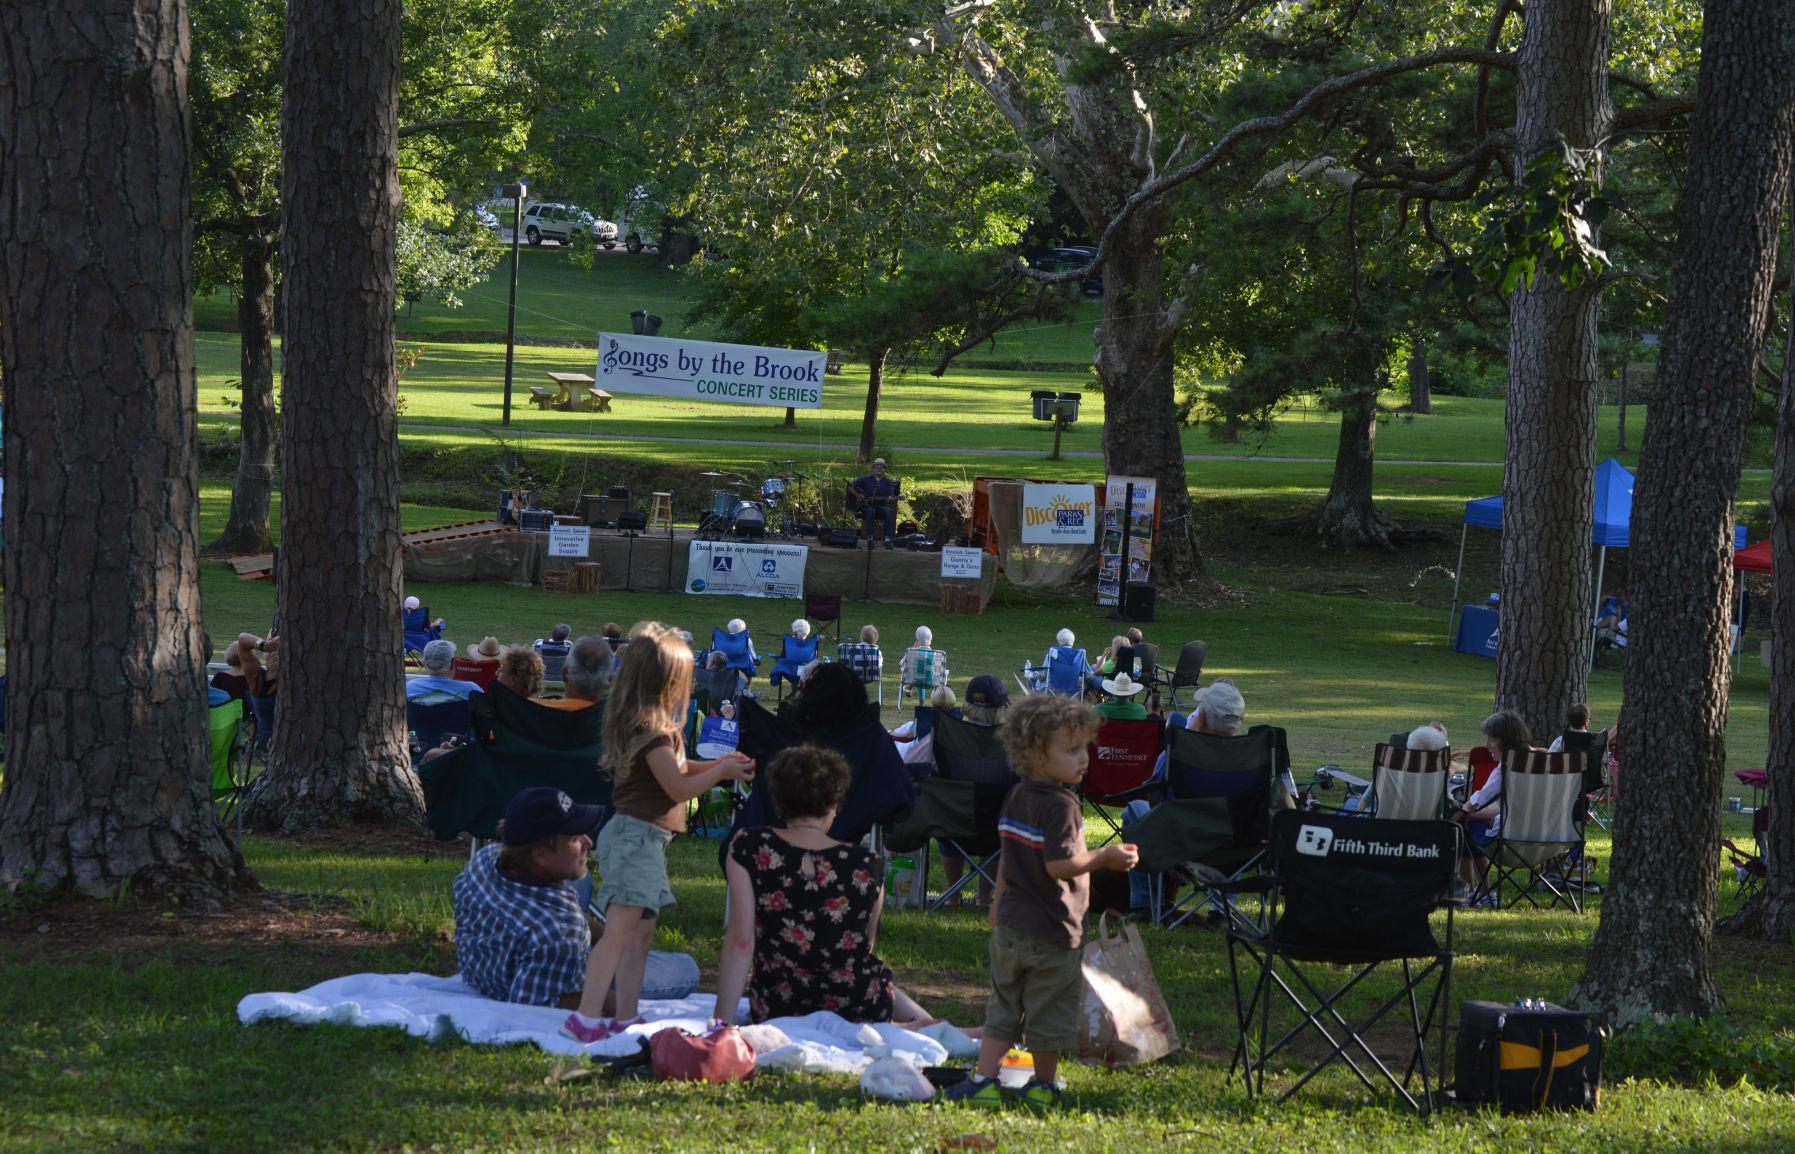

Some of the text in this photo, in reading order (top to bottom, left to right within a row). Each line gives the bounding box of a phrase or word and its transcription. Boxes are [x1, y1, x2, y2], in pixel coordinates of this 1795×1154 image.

[603, 338, 819, 382] Songs by the Brook
[696, 379, 818, 403] CONCERT SERIES
[1058, 510, 1083, 519] PARKS
[1057, 517, 1083, 529] & REC
[695, 543, 712, 552] Thank
[1333, 839, 1366, 854] Fifth
[1367, 841, 1404, 857] Third
[1406, 844, 1440, 859] Bank
